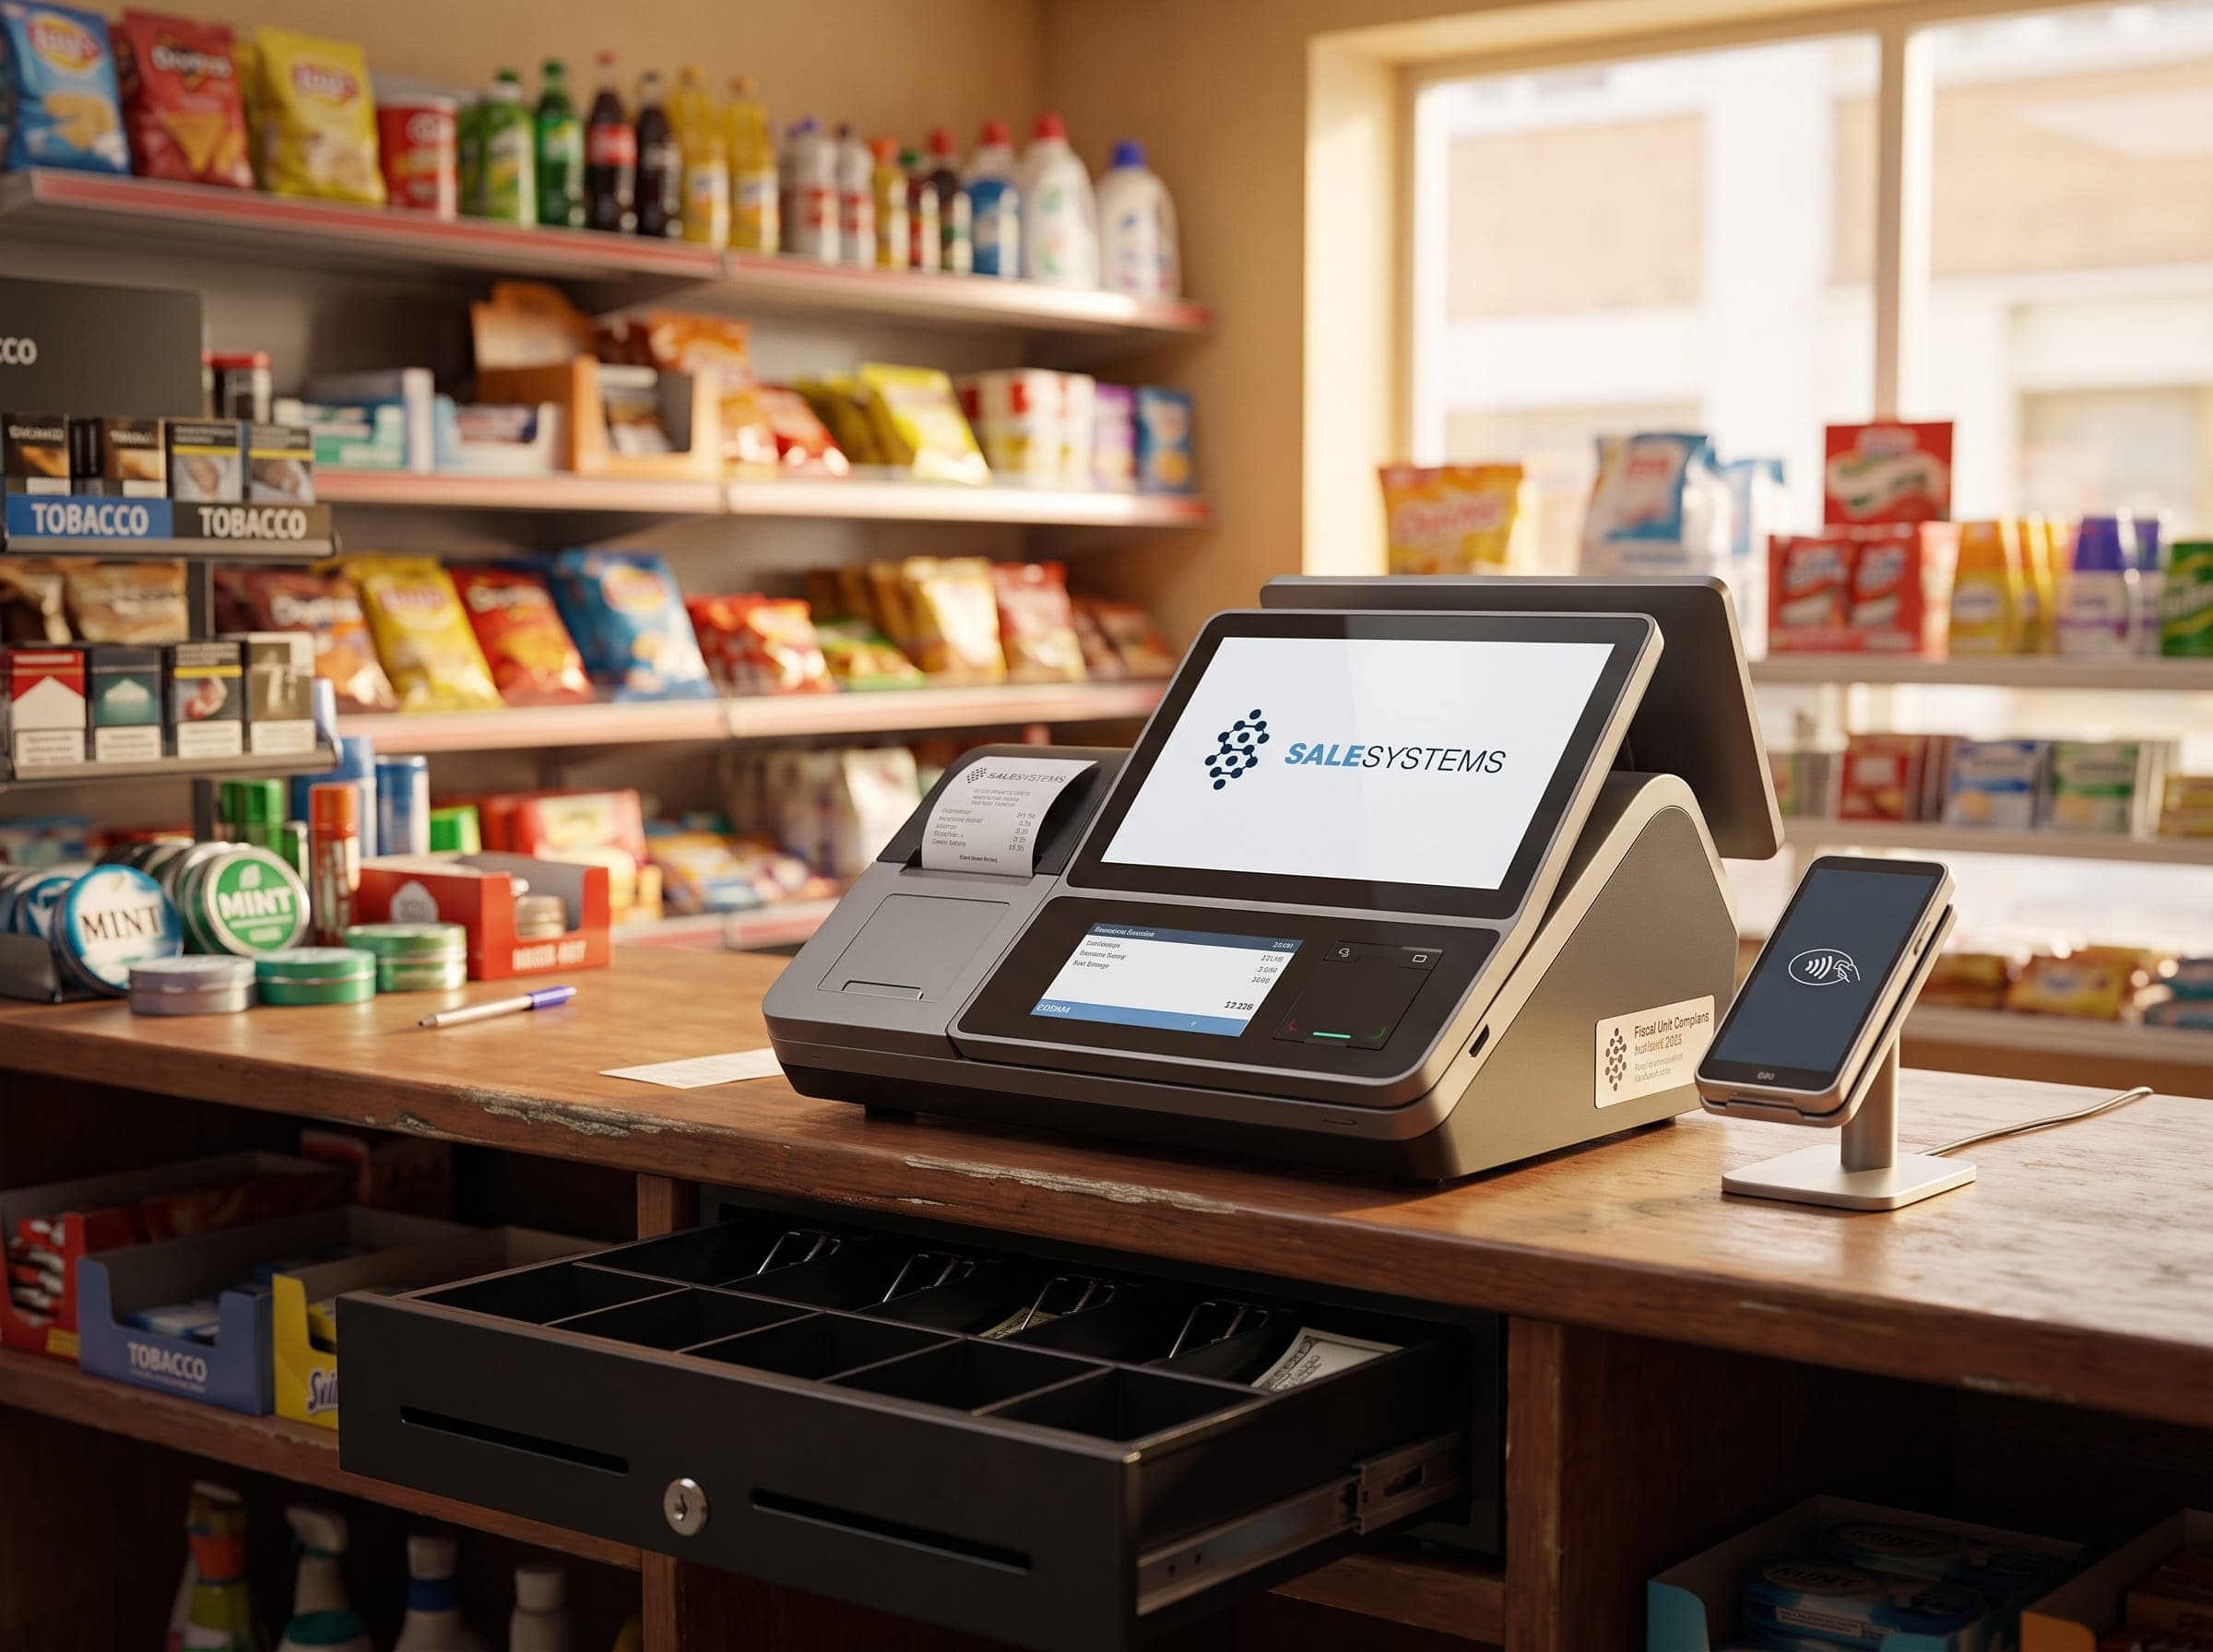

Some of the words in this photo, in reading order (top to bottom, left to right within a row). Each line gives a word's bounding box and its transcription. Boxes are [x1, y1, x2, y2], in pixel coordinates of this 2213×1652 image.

[0, 337, 38, 366] CO
[30, 502, 150, 537] TOBACCO
[197, 507, 308, 540] TOBACCO
[1284, 742, 1507, 774] SALESYSTEMS
[987, 772, 1067, 784] SALESYSTEMS
[219, 886, 293, 920] MINT
[80, 906, 162, 942] MINT
[1634, 1021, 1657, 1039] Fiscal
[1658, 1020, 1673, 1033] Unit
[127, 1342, 207, 1381] TOBACCO
[1773, 1566, 1862, 1587] MINT
